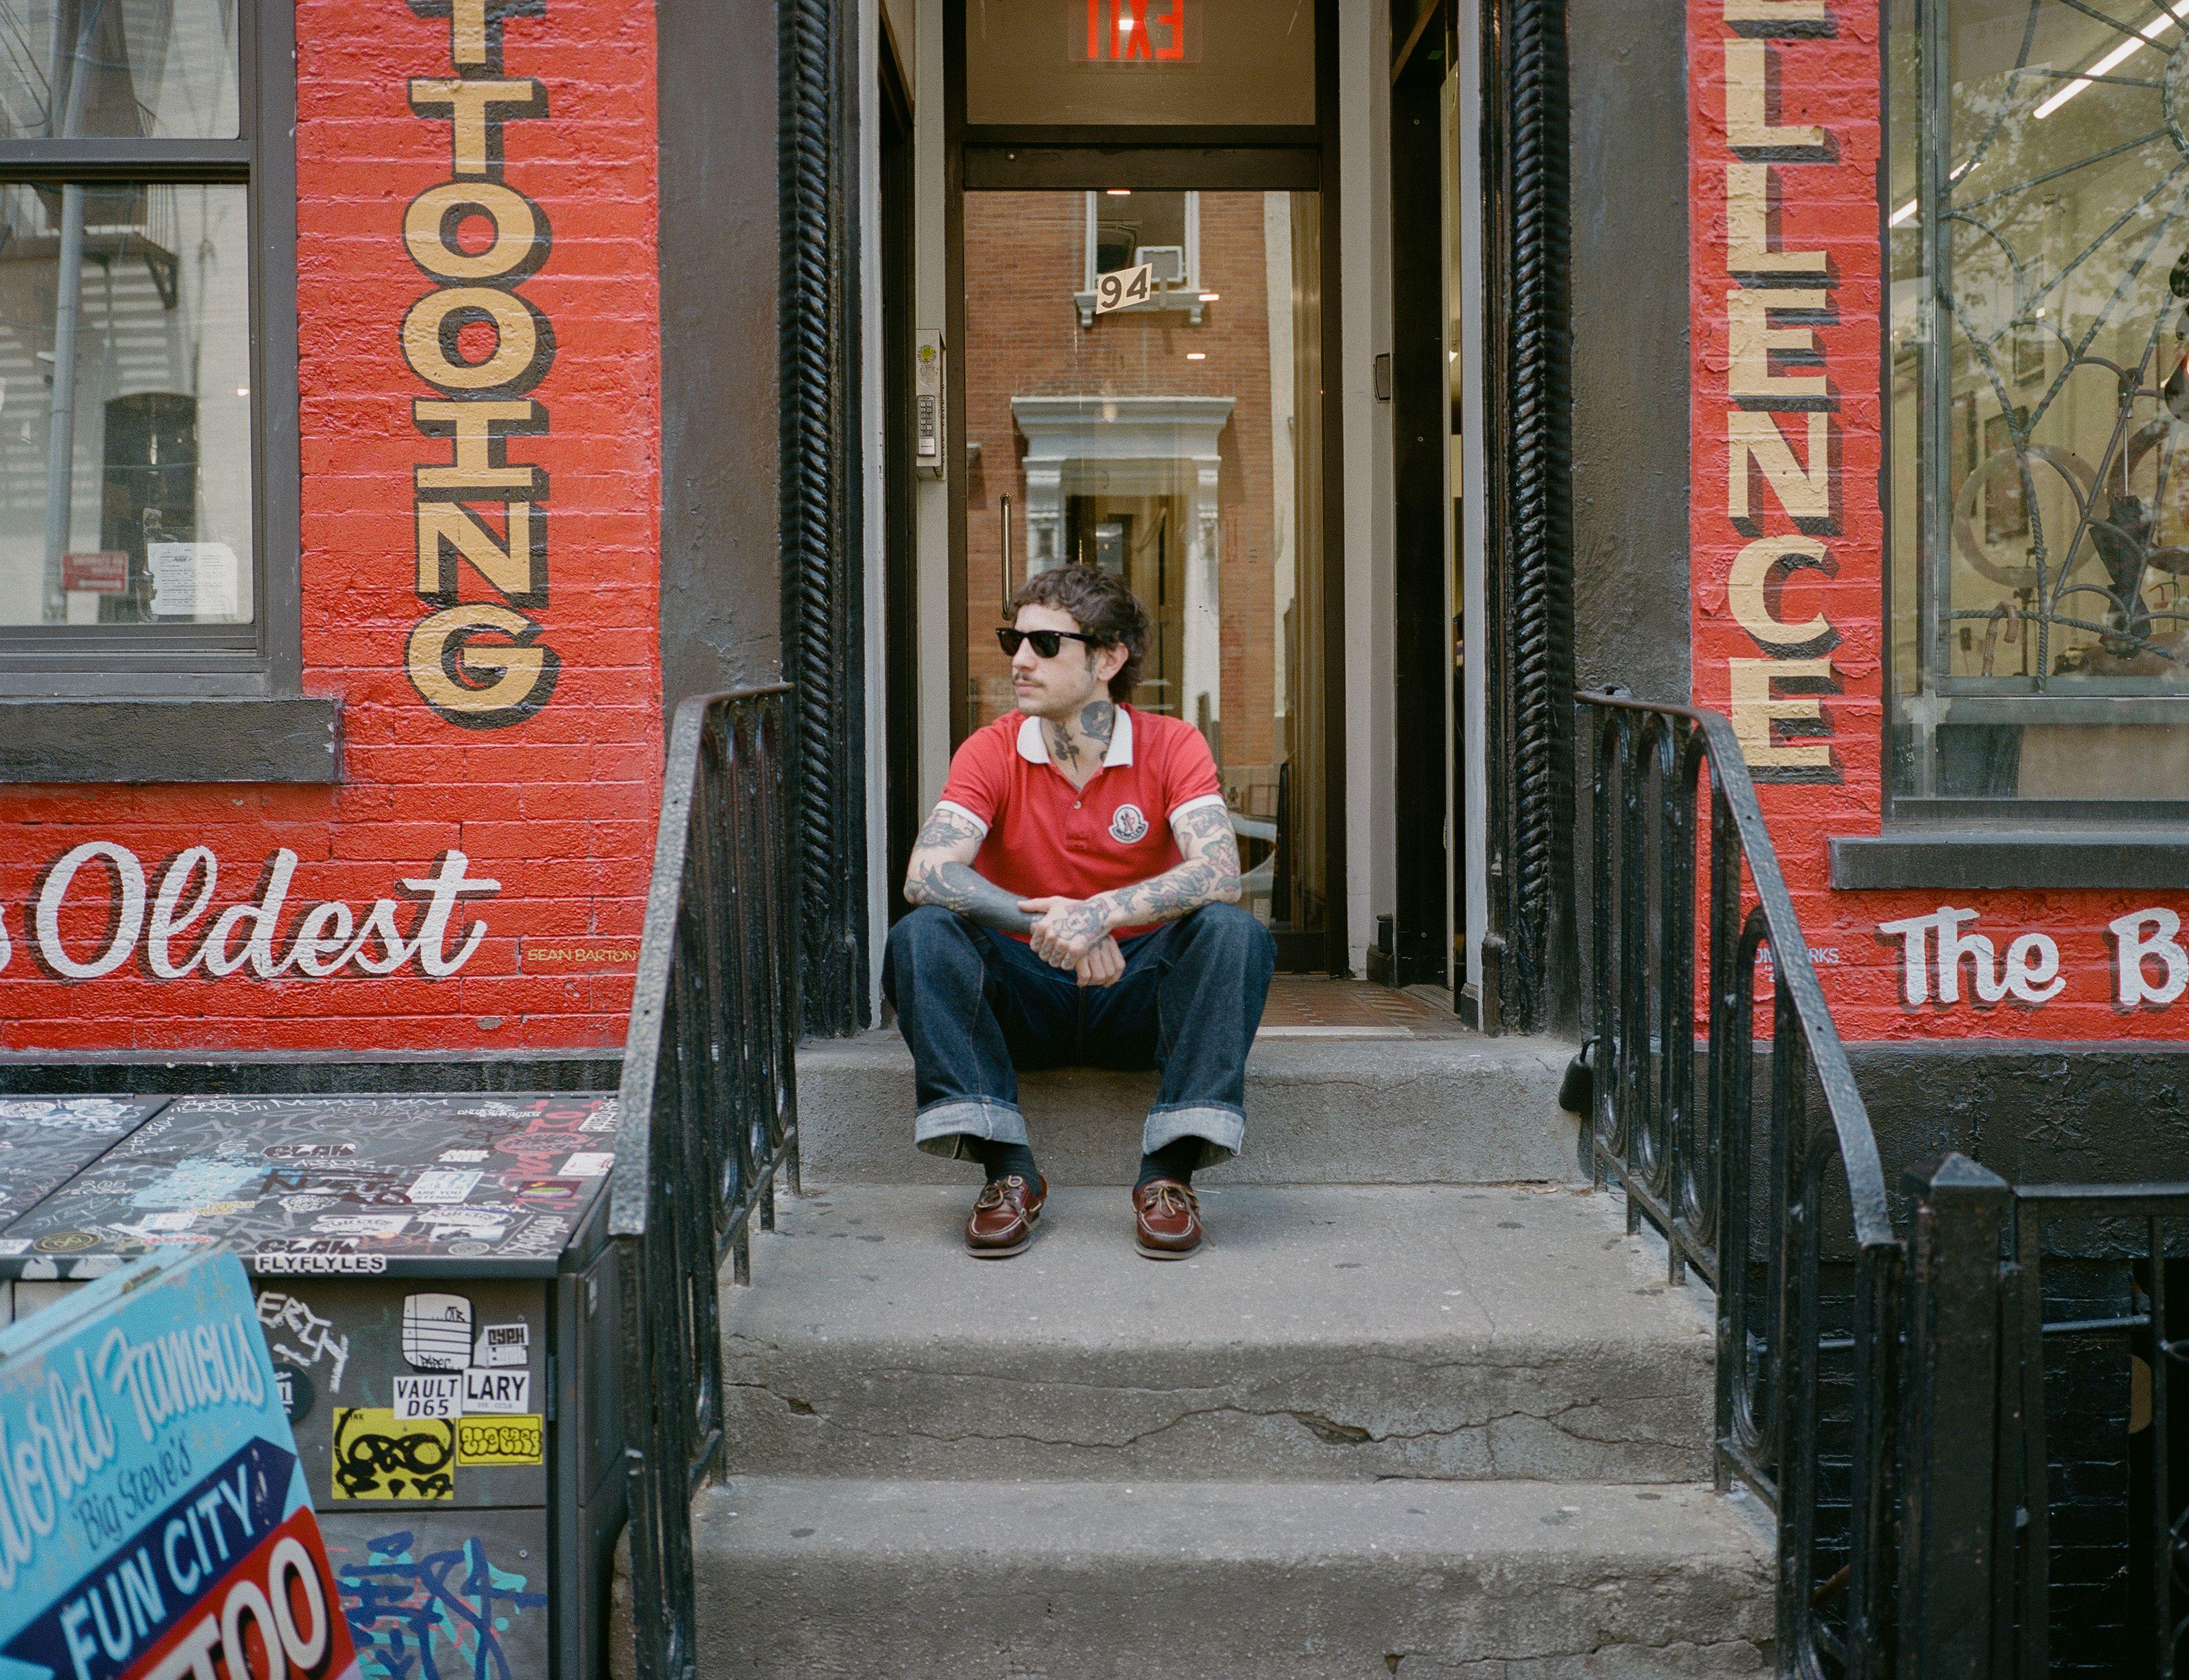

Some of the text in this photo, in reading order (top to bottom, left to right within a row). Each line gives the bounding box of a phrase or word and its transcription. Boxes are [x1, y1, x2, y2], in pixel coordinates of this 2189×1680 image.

[1101, 267, 1148, 308] 94
[1724, 0, 1840, 779] LLENCE
[35, 841, 501, 979] Oldest
[528, 949, 637, 963] SEAN BARTON
[1879, 906, 2067, 1006] The
[258, 1256, 383, 1271] FLYFLYLES
[95, 1314, 265, 1442] Famous
[397, 1378, 457, 1398] VAULT
[468, 1375, 526, 1400] LARY
[407, 1400, 448, 1417] D65
[59, 1547, 167, 1680] FUN
